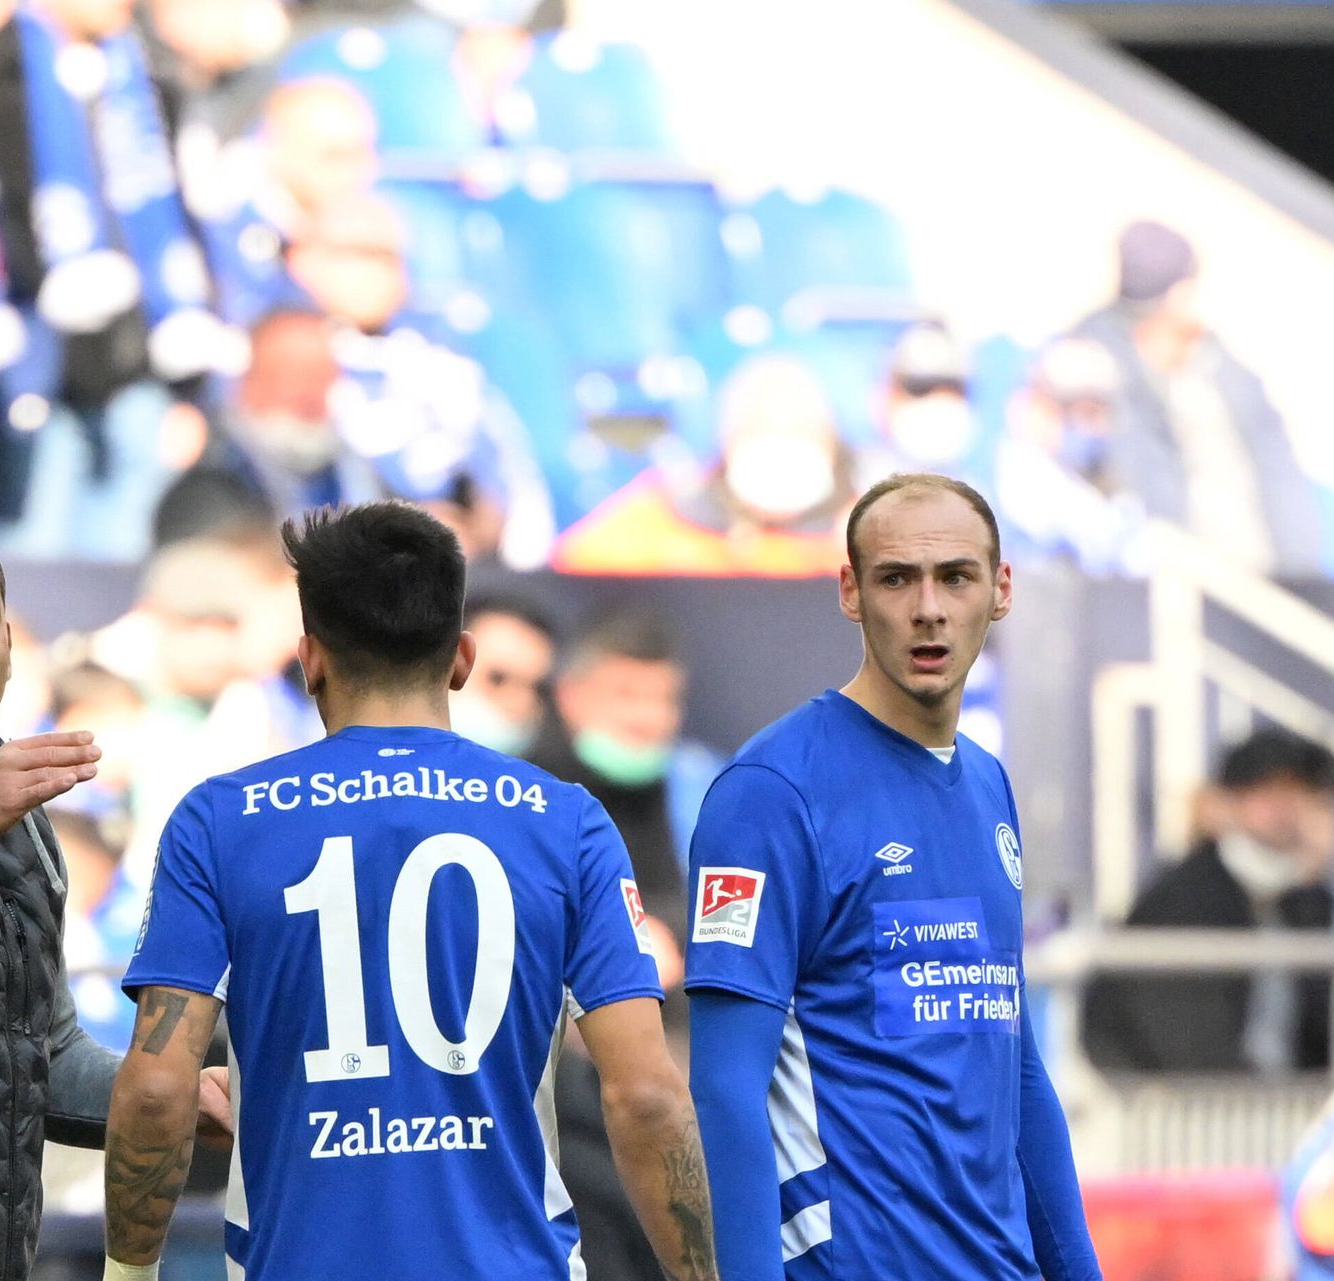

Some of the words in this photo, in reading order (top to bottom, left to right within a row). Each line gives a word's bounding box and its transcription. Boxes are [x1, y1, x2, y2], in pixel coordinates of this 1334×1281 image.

[242, 776, 302, 816] FC
[310, 767, 488, 808] Schalke
[495, 776, 548, 814] 04
[882, 864, 913, 877] umbro
[698, 926, 747, 939] BUNDESLIGA
[914, 921, 979, 942] VIVAWEST
[283, 832, 516, 1084] 10
[913, 993, 952, 1022] für
[308, 1107, 494, 1160] Zalazar
